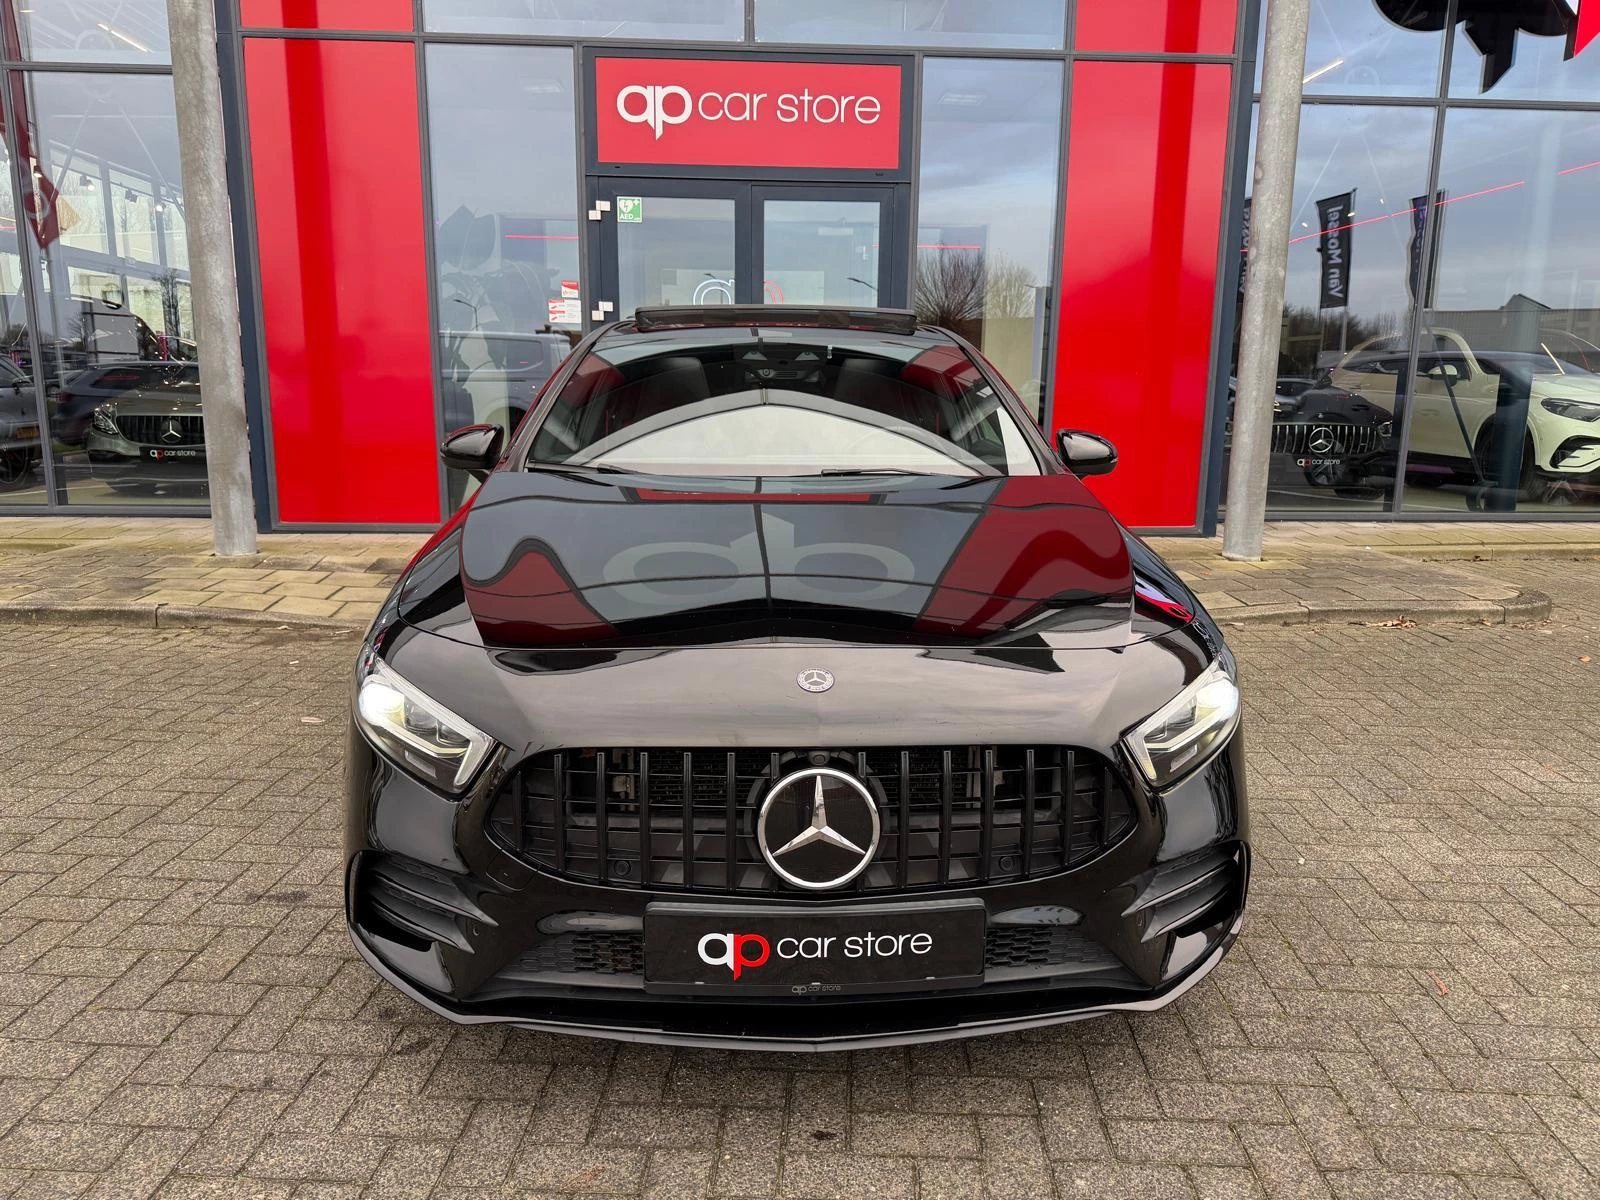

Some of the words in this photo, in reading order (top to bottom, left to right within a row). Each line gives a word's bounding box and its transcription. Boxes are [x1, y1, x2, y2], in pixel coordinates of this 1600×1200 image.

[698, 91, 768, 121] car
[776, 88, 881, 124] store
[776, 936, 836, 959] car
[844, 931, 933, 957] store
